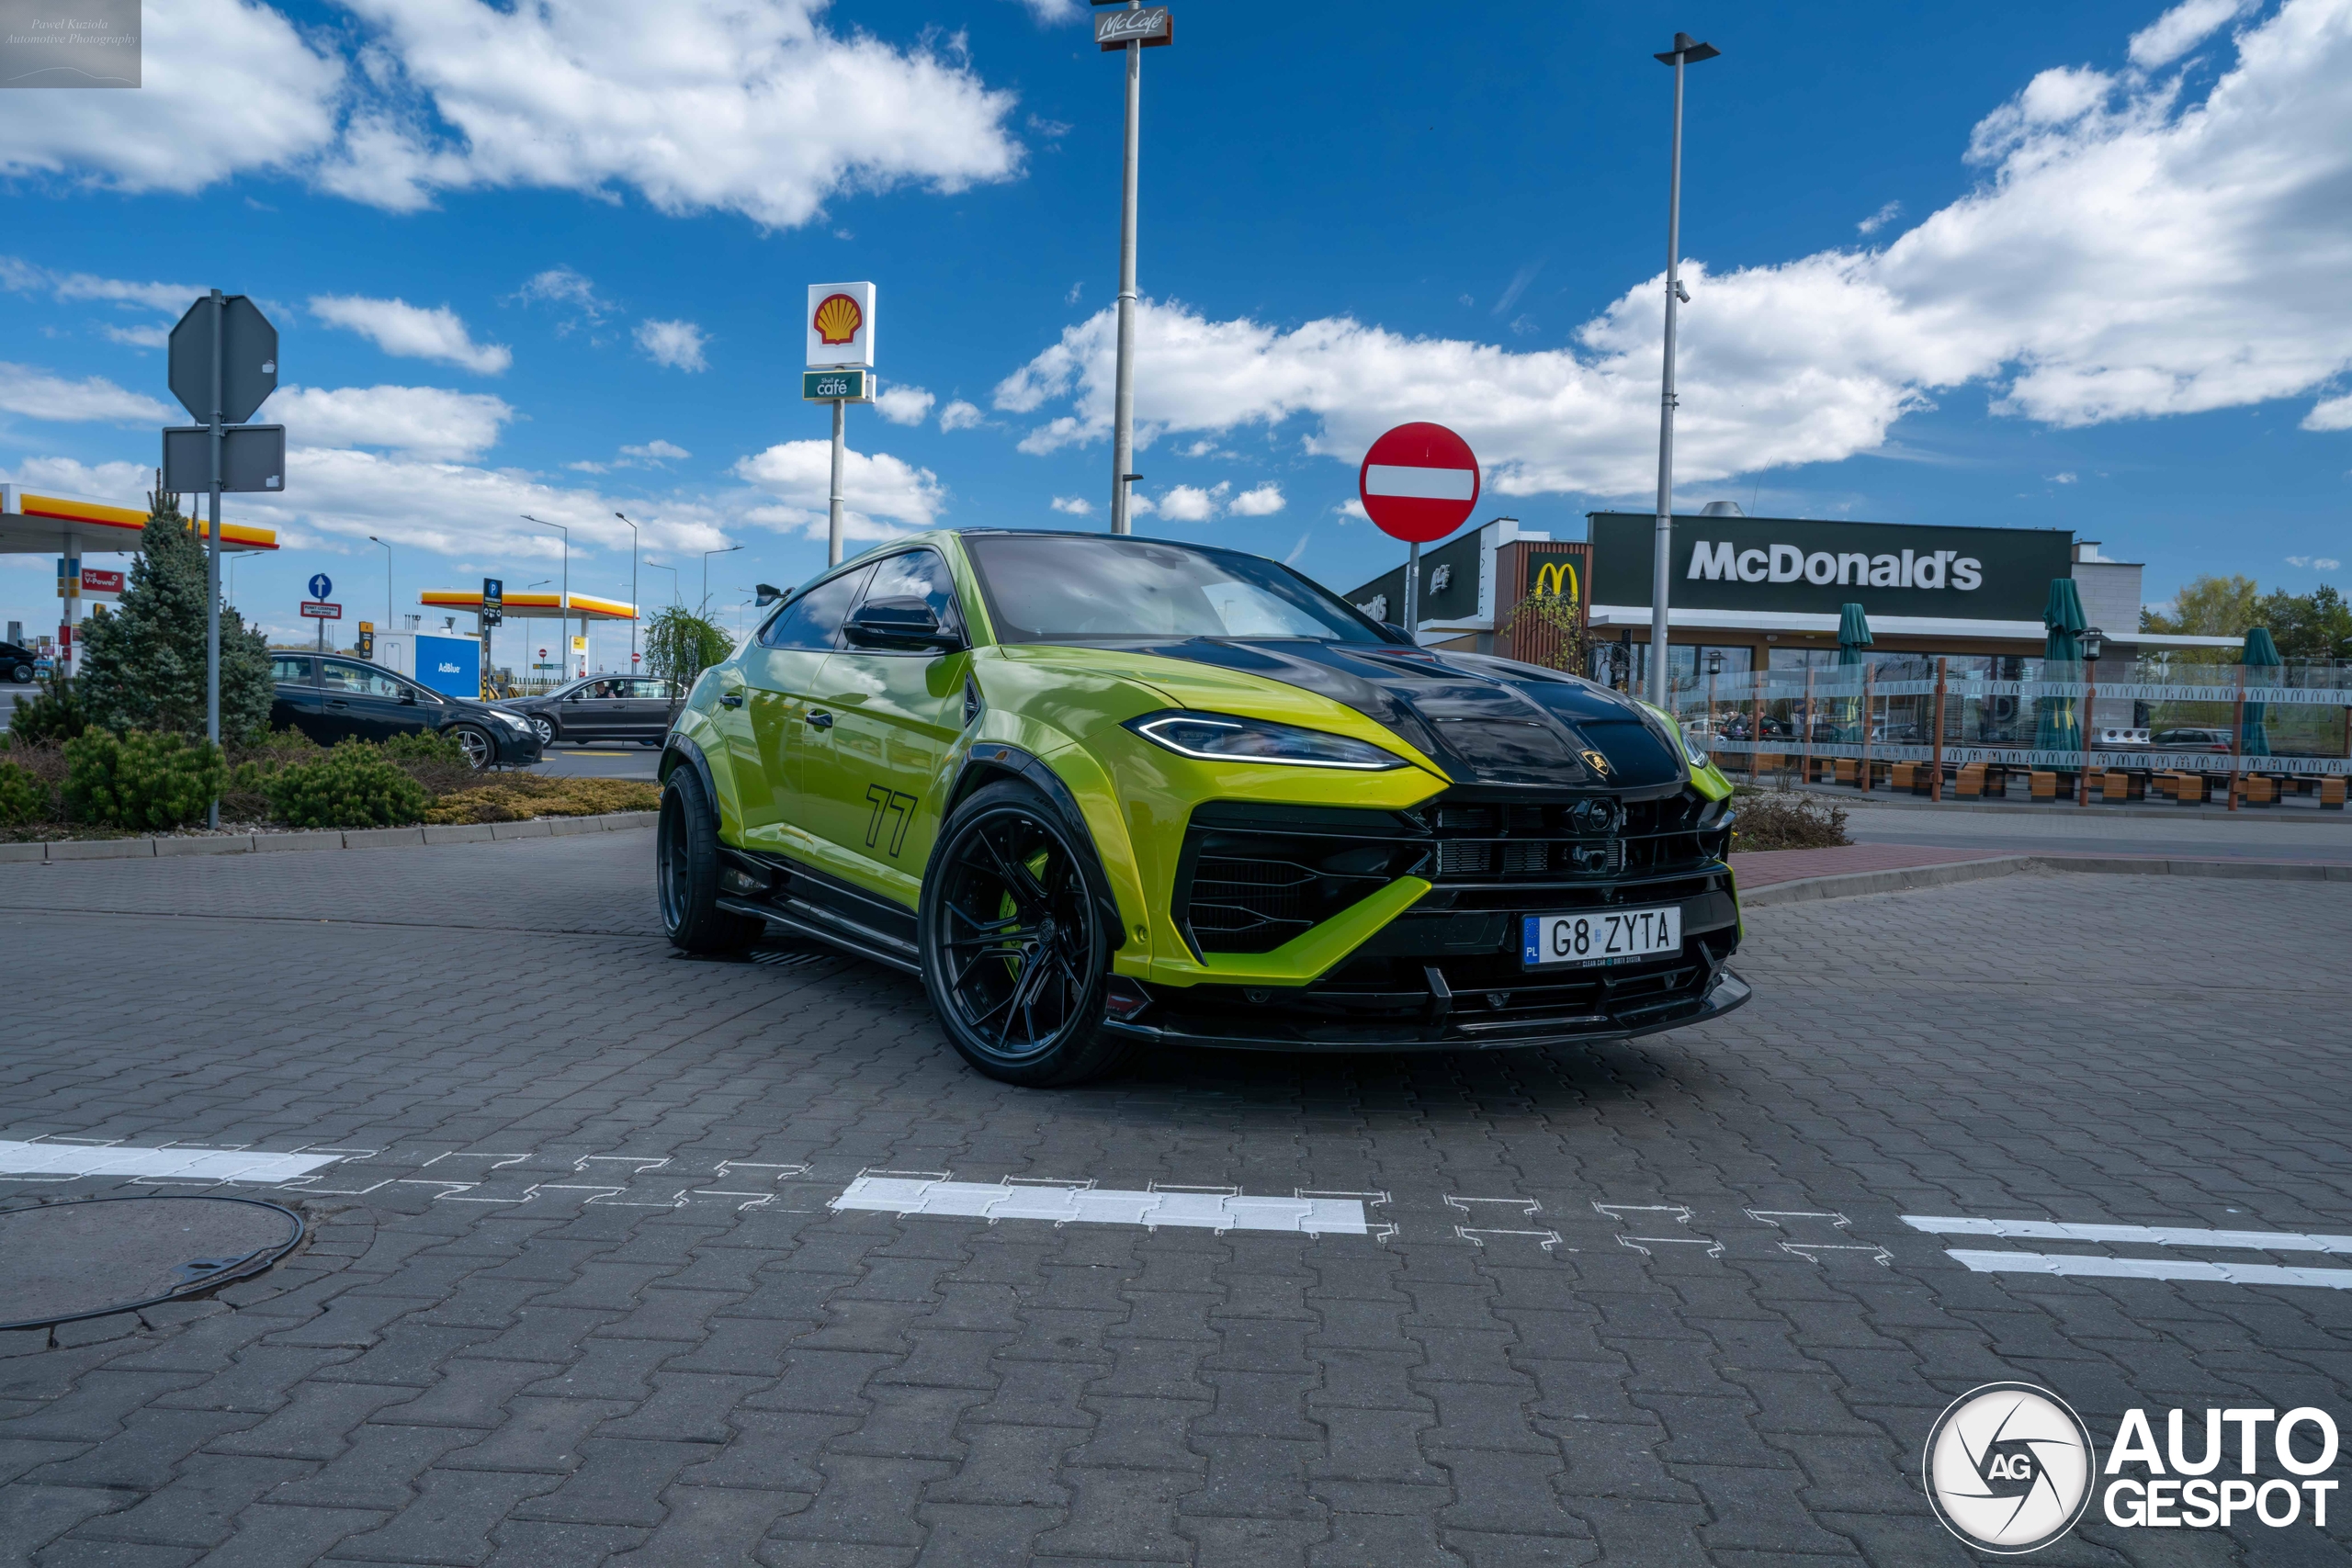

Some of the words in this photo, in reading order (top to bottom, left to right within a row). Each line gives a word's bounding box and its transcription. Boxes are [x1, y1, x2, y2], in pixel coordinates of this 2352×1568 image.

[1098, 9, 1164, 41] McCafé
[817, 378, 847, 395] café
[1687, 540, 1983, 591] McDonald's
[85, 577, 116, 586] V-Power
[438, 661, 461, 673] AdBlue
[865, 783, 918, 859] 77
[1553, 919, 1589, 957] G8
[1605, 911, 1669, 953] ZYTA
[1526, 946, 1538, 957] PL
